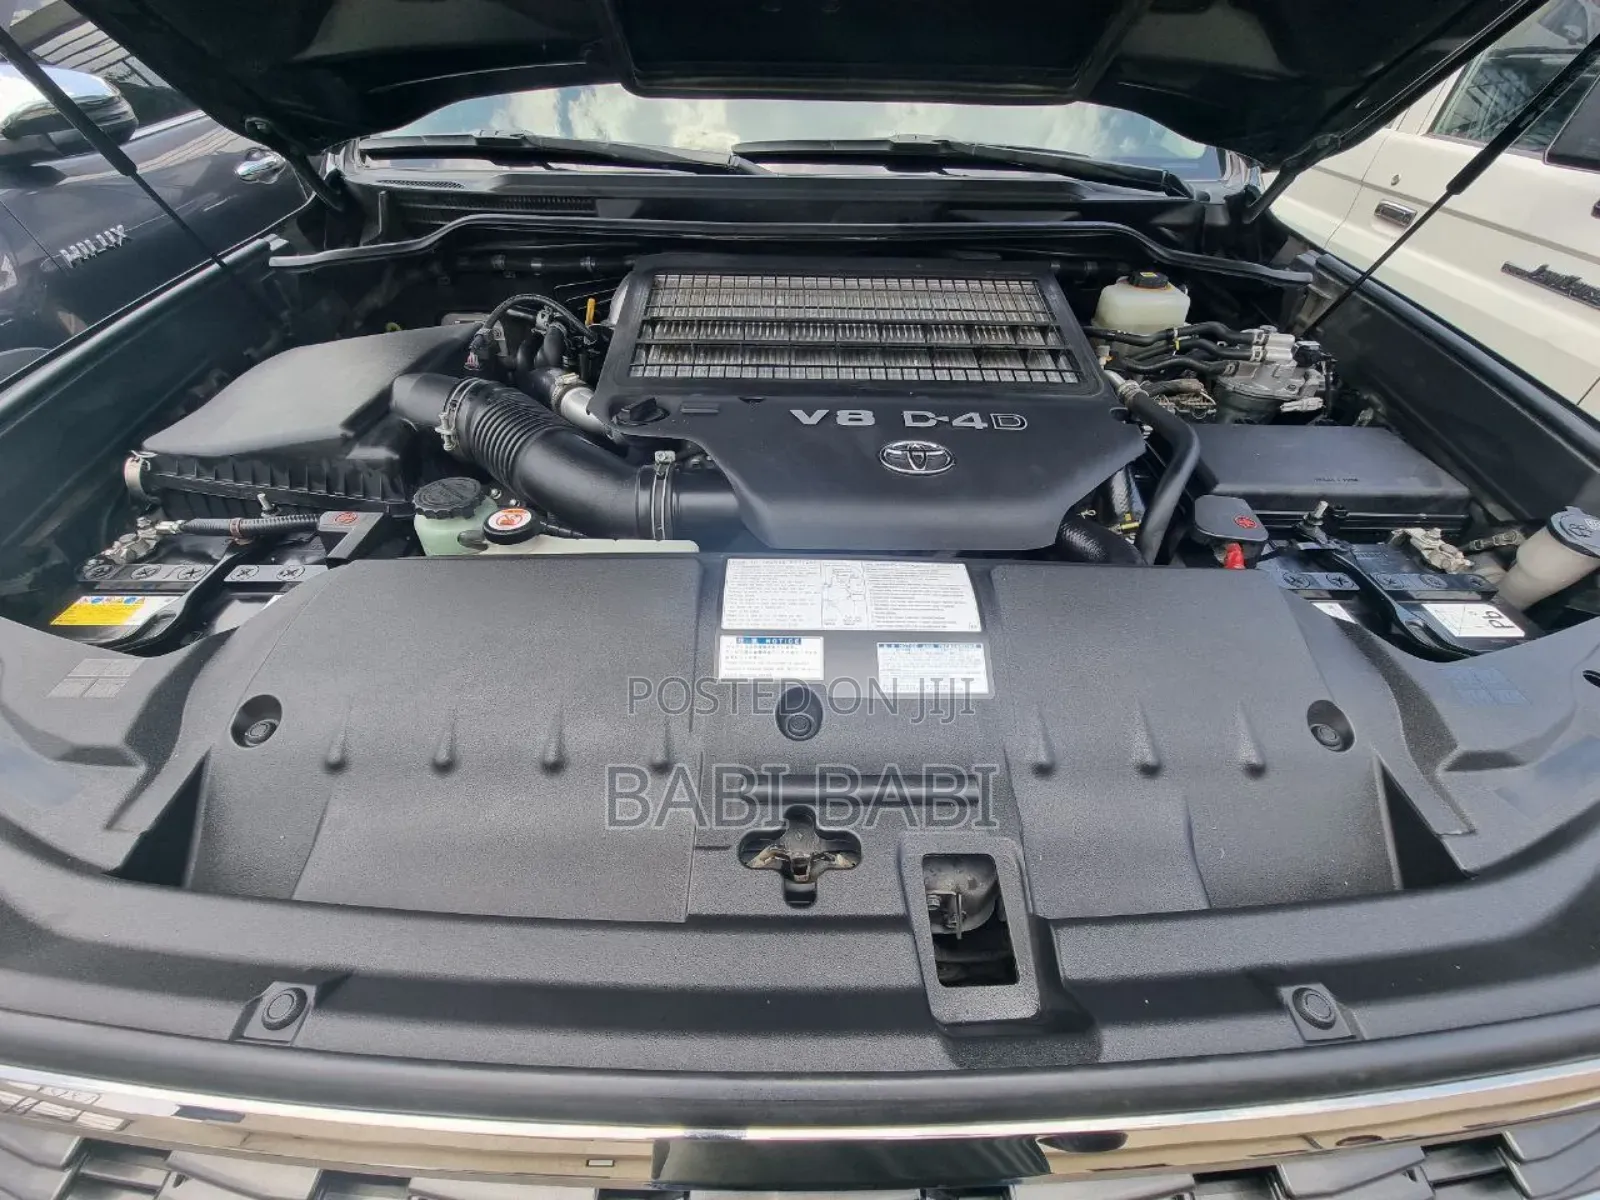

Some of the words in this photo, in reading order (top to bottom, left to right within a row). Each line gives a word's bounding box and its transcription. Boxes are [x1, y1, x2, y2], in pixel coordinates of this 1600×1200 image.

[60, 224, 128, 269] HILUX
[789, 409, 876, 426] V8
[902, 410, 1028, 431] D-4D
